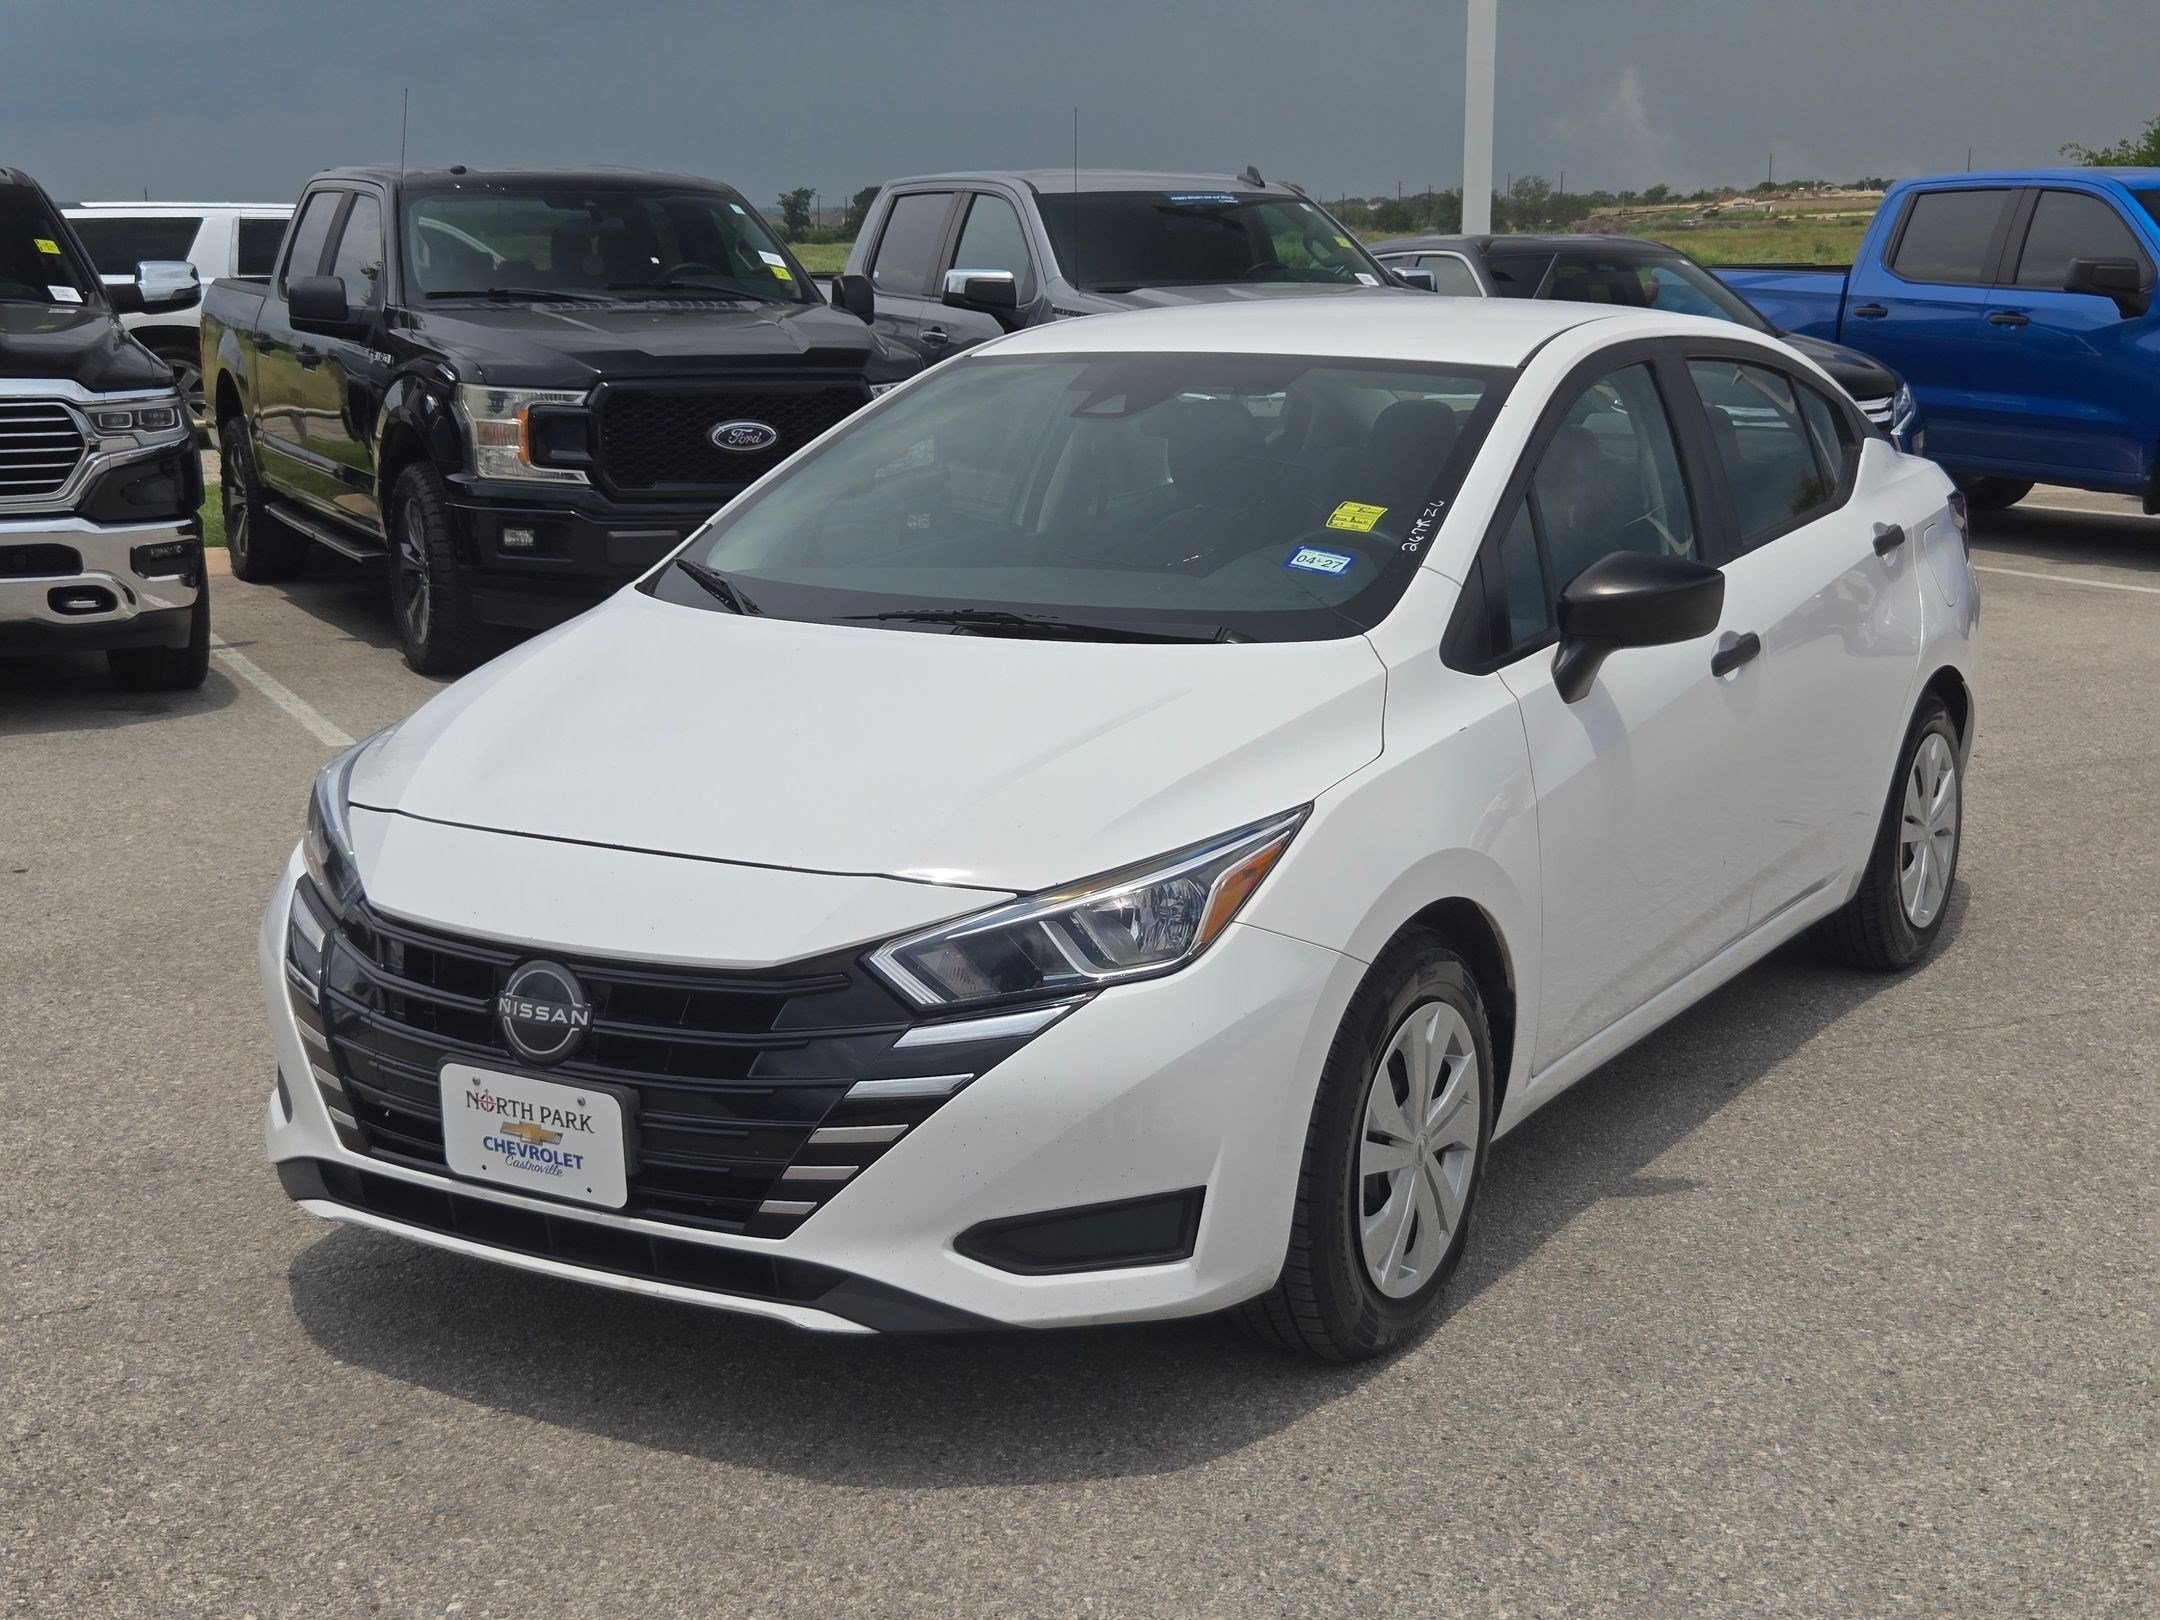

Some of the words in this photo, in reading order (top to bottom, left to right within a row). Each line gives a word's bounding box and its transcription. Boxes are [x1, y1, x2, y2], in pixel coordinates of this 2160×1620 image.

[728, 428, 762, 444] Ford
[1296, 553, 1315, 564] 04
[1321, 559, 1343, 570] 27
[499, 997, 588, 1025] NISSAN
[465, 1089, 534, 1121] NORTH
[540, 1105, 596, 1133] PARK
[483, 1135, 583, 1170] CHEVROLET
[505, 1153, 564, 1177] Castroville
